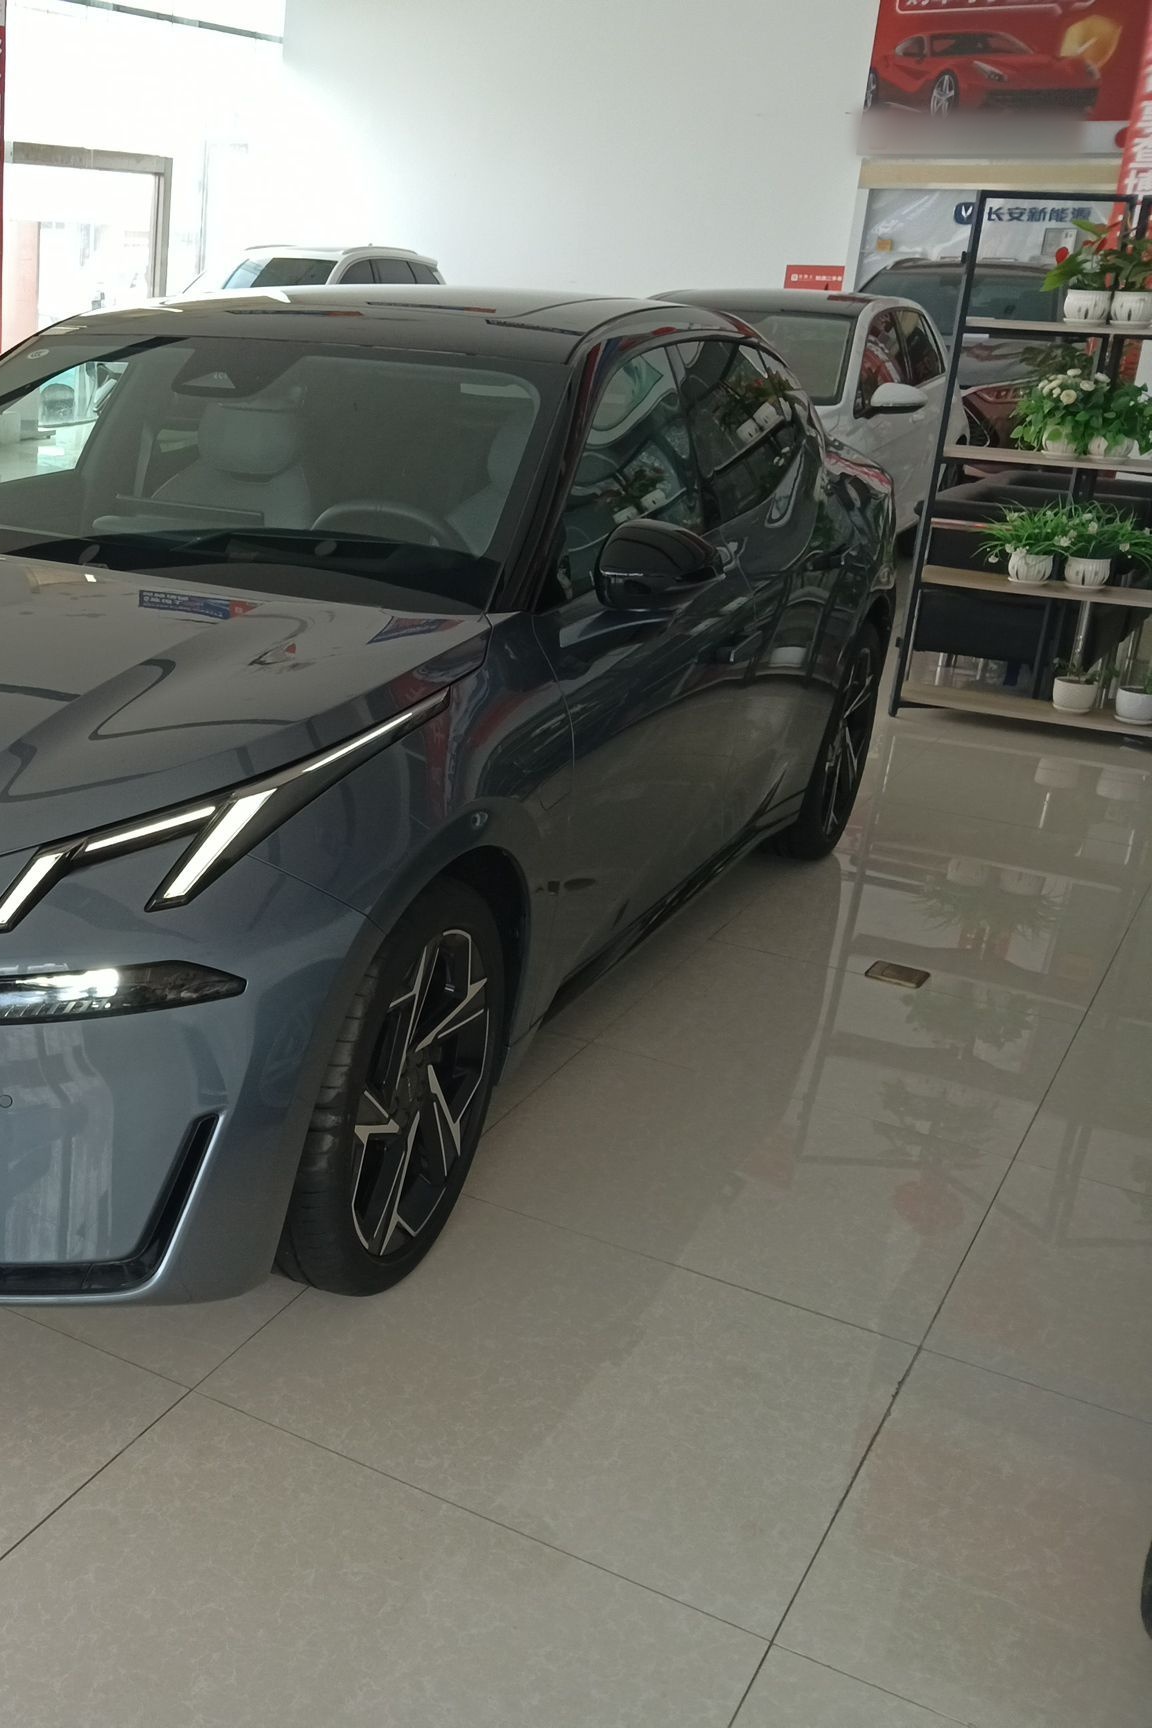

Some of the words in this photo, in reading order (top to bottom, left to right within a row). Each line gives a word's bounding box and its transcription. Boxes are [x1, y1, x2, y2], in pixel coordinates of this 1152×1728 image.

[987, 206, 1092, 223] 长安新能源
